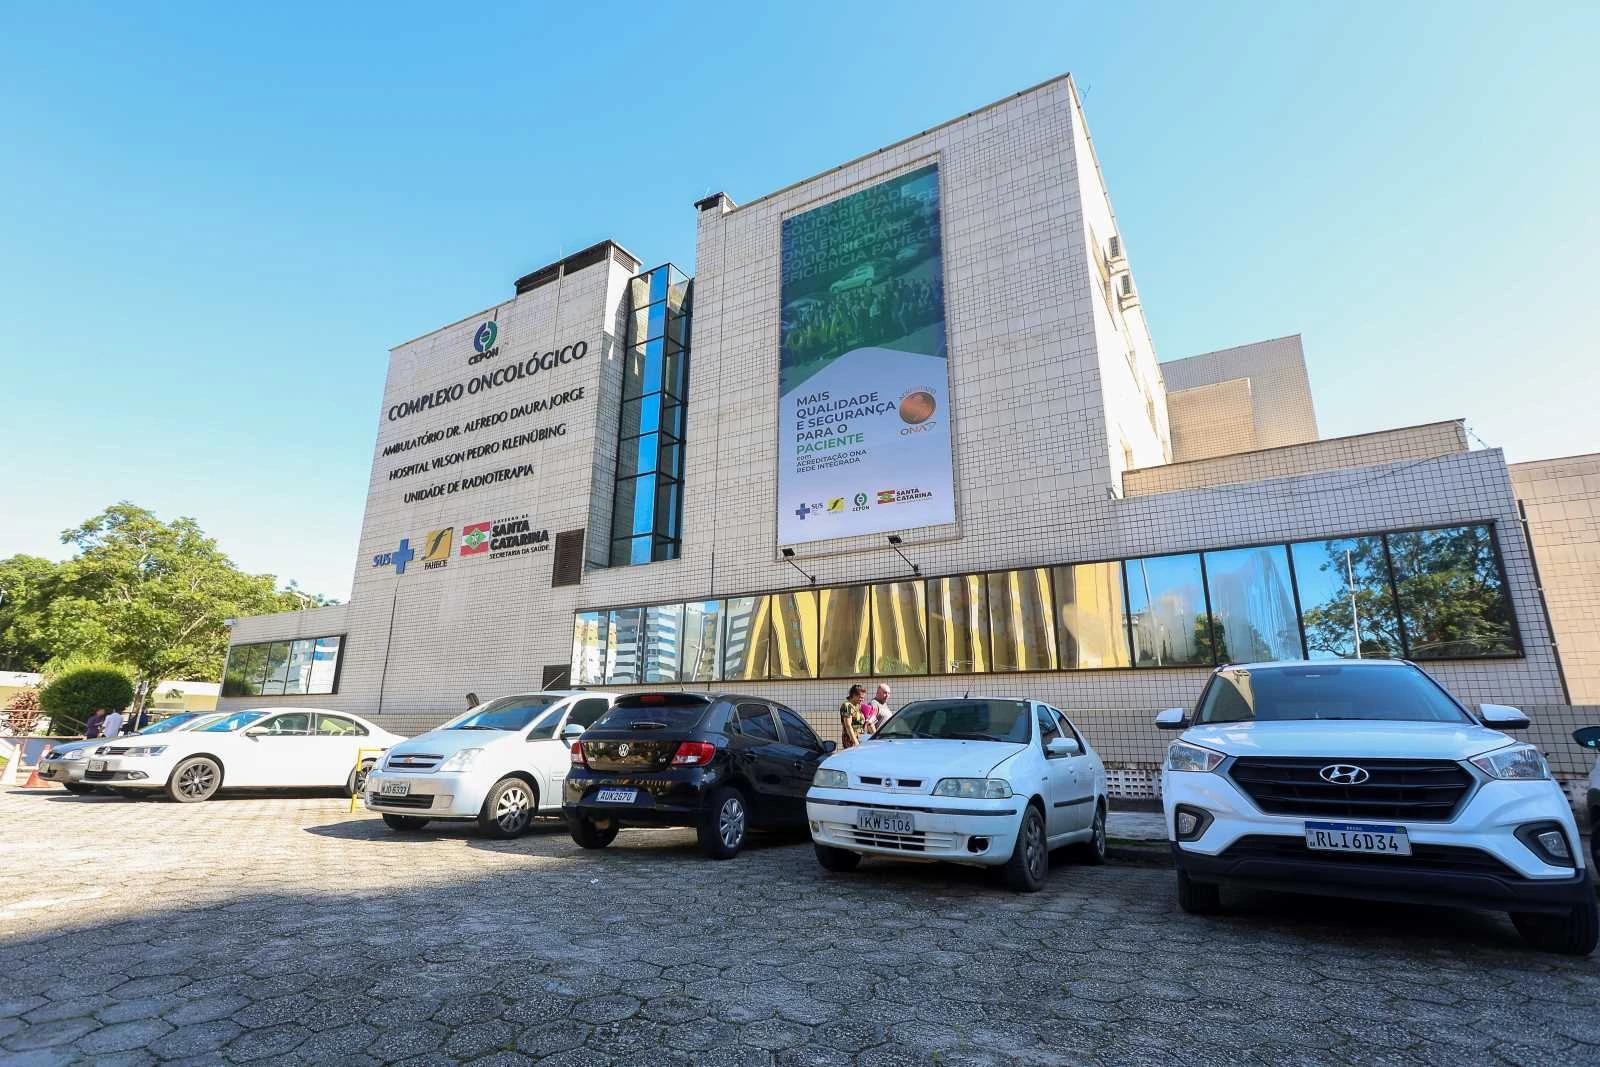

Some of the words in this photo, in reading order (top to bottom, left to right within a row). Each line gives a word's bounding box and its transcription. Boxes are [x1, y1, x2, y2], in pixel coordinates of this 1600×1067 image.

[468, 347, 499, 365] CEPON
[388, 383, 464, 421] COMPLEXO
[467, 340, 588, 395] ONCOLÓGICO
[796, 391, 830, 408] MAIS
[796, 392, 879, 419] QUALIDADE
[382, 429, 444, 457] AMBULATÓRIO
[446, 425, 461, 440] DR.
[463, 410, 508, 434] ALFREDO
[510, 399, 548, 420] DAURA
[548, 386, 585, 411] JORGE
[796, 421, 804, 431] E
[808, 400, 896, 428] SEGURANÇA
[796, 428, 834, 443] PARA
[837, 423, 848, 434] O
[796, 432, 865, 455] PACIENTE
[389, 461, 429, 481] HOSPITAL
[431, 451, 465, 470] VILSON
[466, 441, 499, 460] PEDRO
[796, 452, 848, 467] ACREDITAÇÃO
[850, 449, 867, 457] ONA
[817, 457, 860, 470] INTEGRADA
[403, 483, 445, 504] UNIDADE
[446, 480, 460, 494] DE
[461, 464, 534, 491] RADIOTERAPIA
[896, 488, 919, 496] SANTA
[896, 492, 932, 502] CATARINA
[491, 520, 530, 538] SANTA
[490, 530, 550, 551] CATARINA
[372, 552, 391, 567] SUS
[488, 549, 521, 559] SECRETARIA
[860, 815, 881, 829] IKW
[883, 818, 911, 831] 5106
[1316, 831, 1399, 852] RLI6D34
